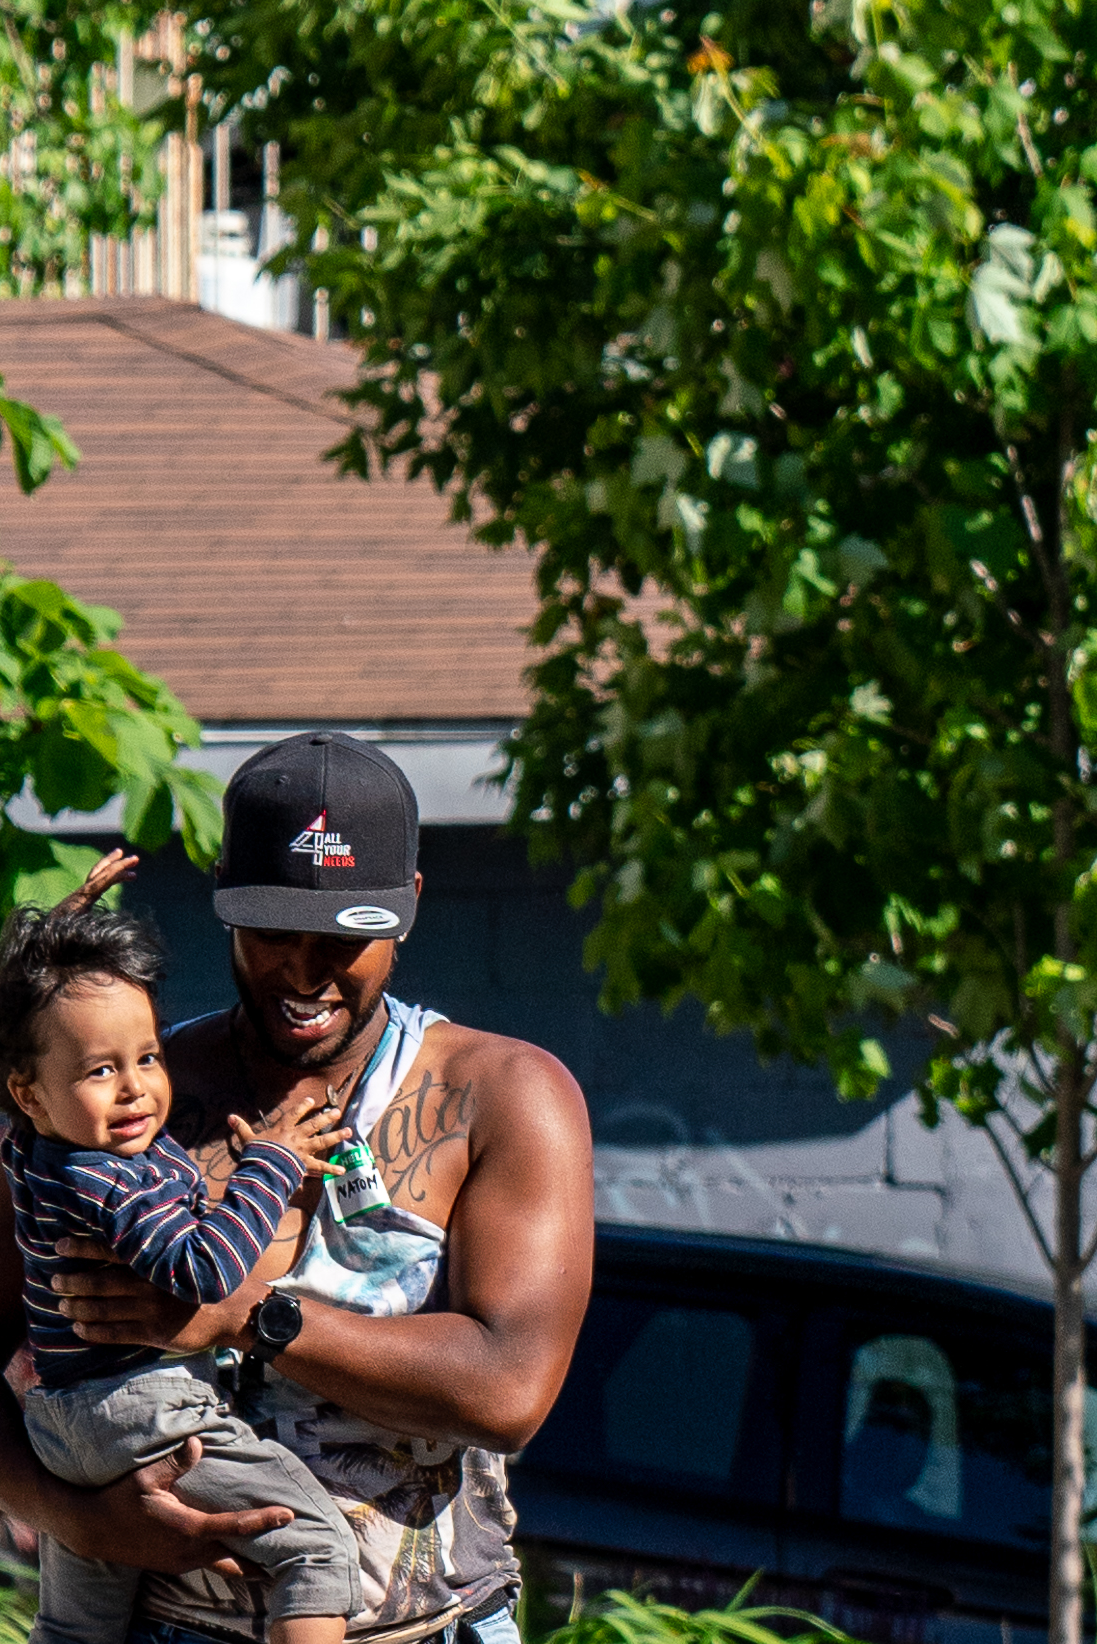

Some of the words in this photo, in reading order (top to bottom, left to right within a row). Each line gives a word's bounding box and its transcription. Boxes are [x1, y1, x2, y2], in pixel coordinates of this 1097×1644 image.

[324, 832, 342, 845] ALL
[324, 844, 351, 857] YOUR
[323, 856, 356, 868] NEEDS
